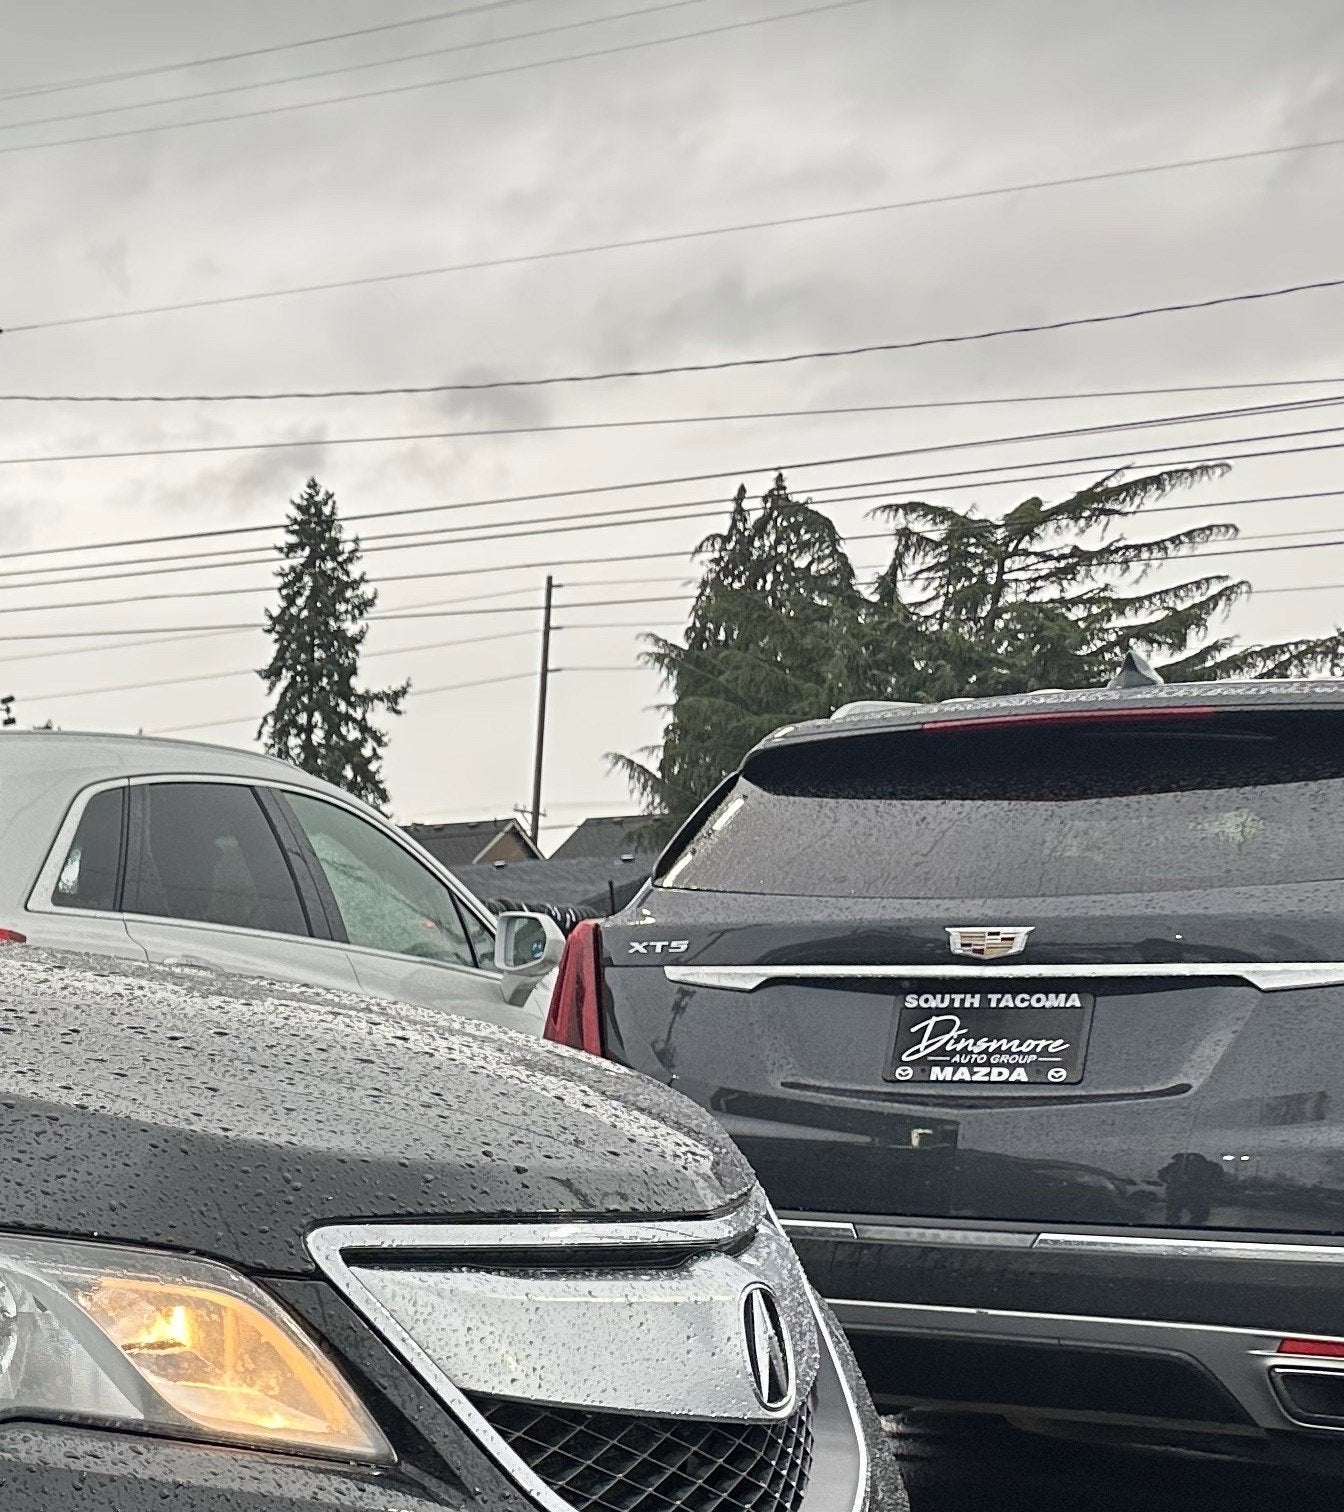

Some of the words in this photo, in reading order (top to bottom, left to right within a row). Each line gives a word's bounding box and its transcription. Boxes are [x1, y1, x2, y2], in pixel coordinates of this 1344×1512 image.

[628, 940, 689, 954] XT5
[904, 993, 981, 1009] SOUTH
[987, 993, 1082, 1008] TACOMA
[901, 1014, 1070, 1062] Dinsmore
[950, 1054, 986, 1064] AUTO
[990, 1054, 1037, 1064] GROUP
[929, 1066, 1029, 1082] MAZDA
